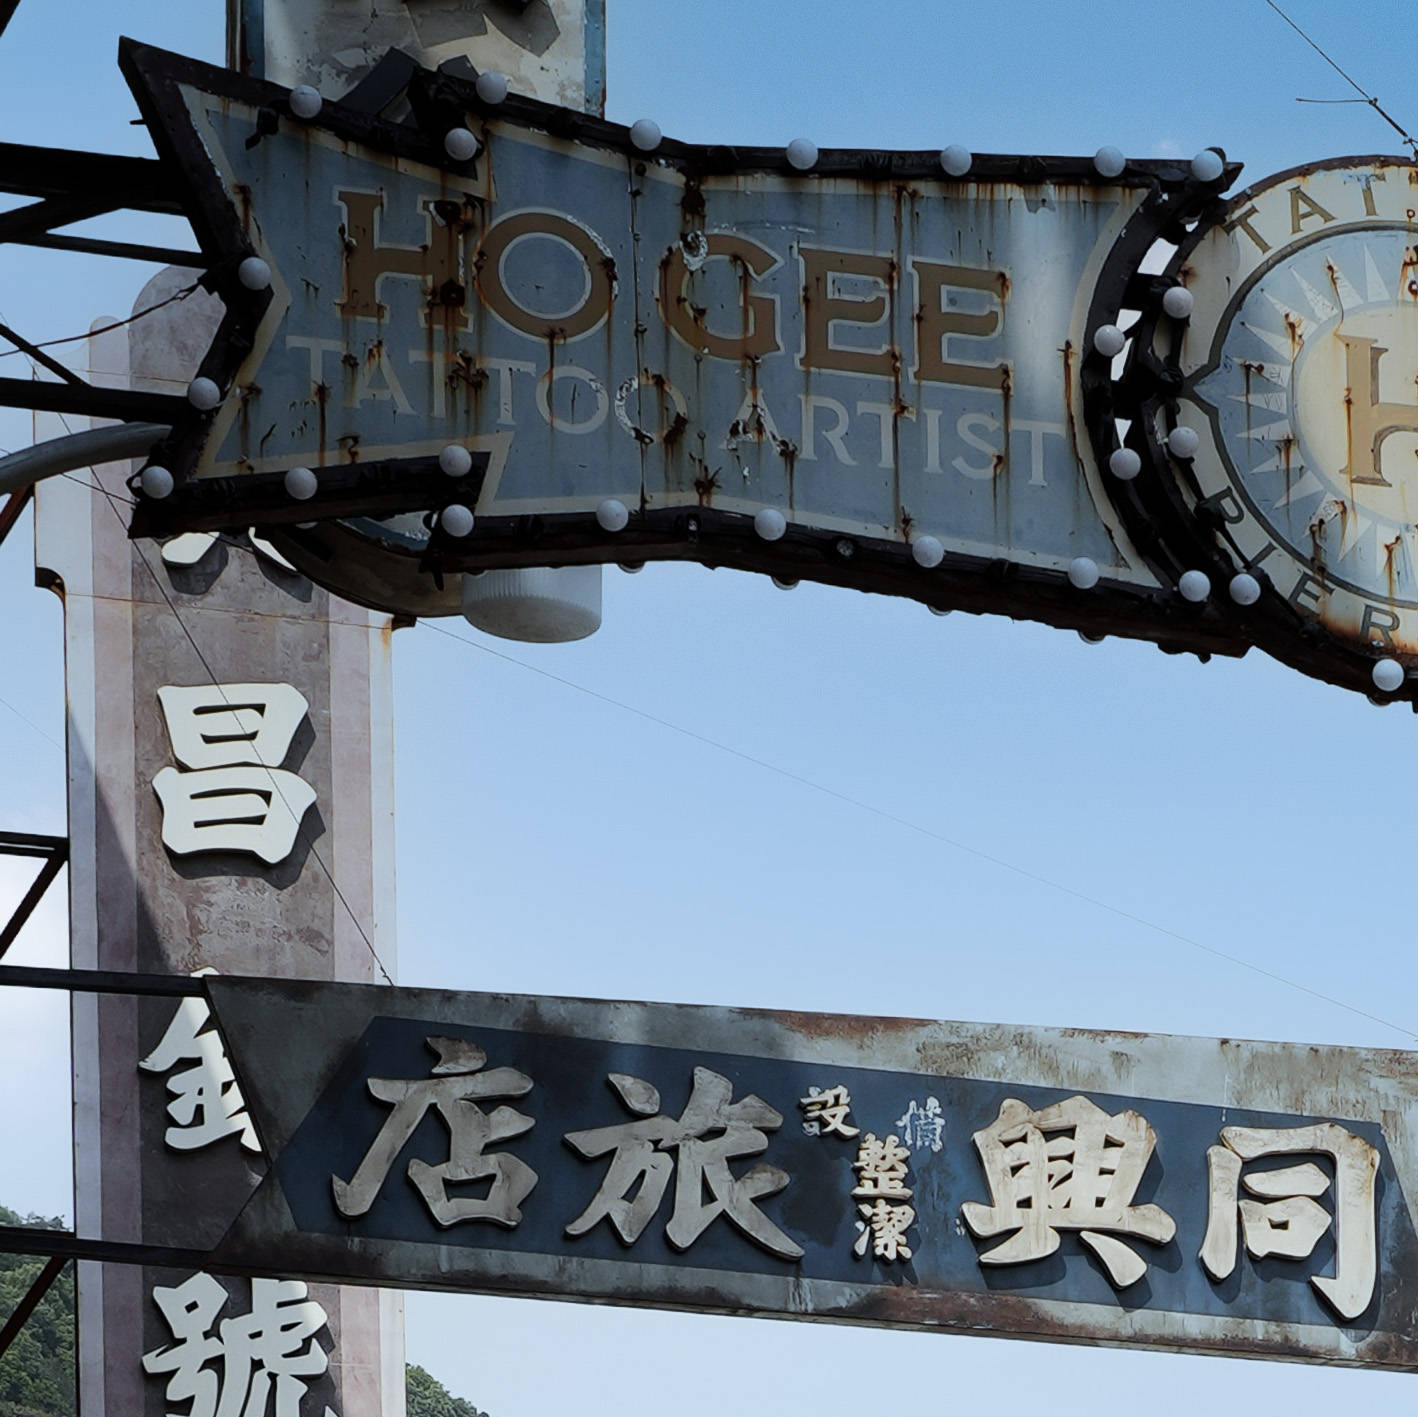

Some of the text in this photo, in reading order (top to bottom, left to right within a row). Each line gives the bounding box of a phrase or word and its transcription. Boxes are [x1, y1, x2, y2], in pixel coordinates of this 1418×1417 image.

[334, 189, 1013, 395] HOGEE
[286, 336, 1067, 487] TATTOO ARTIST
